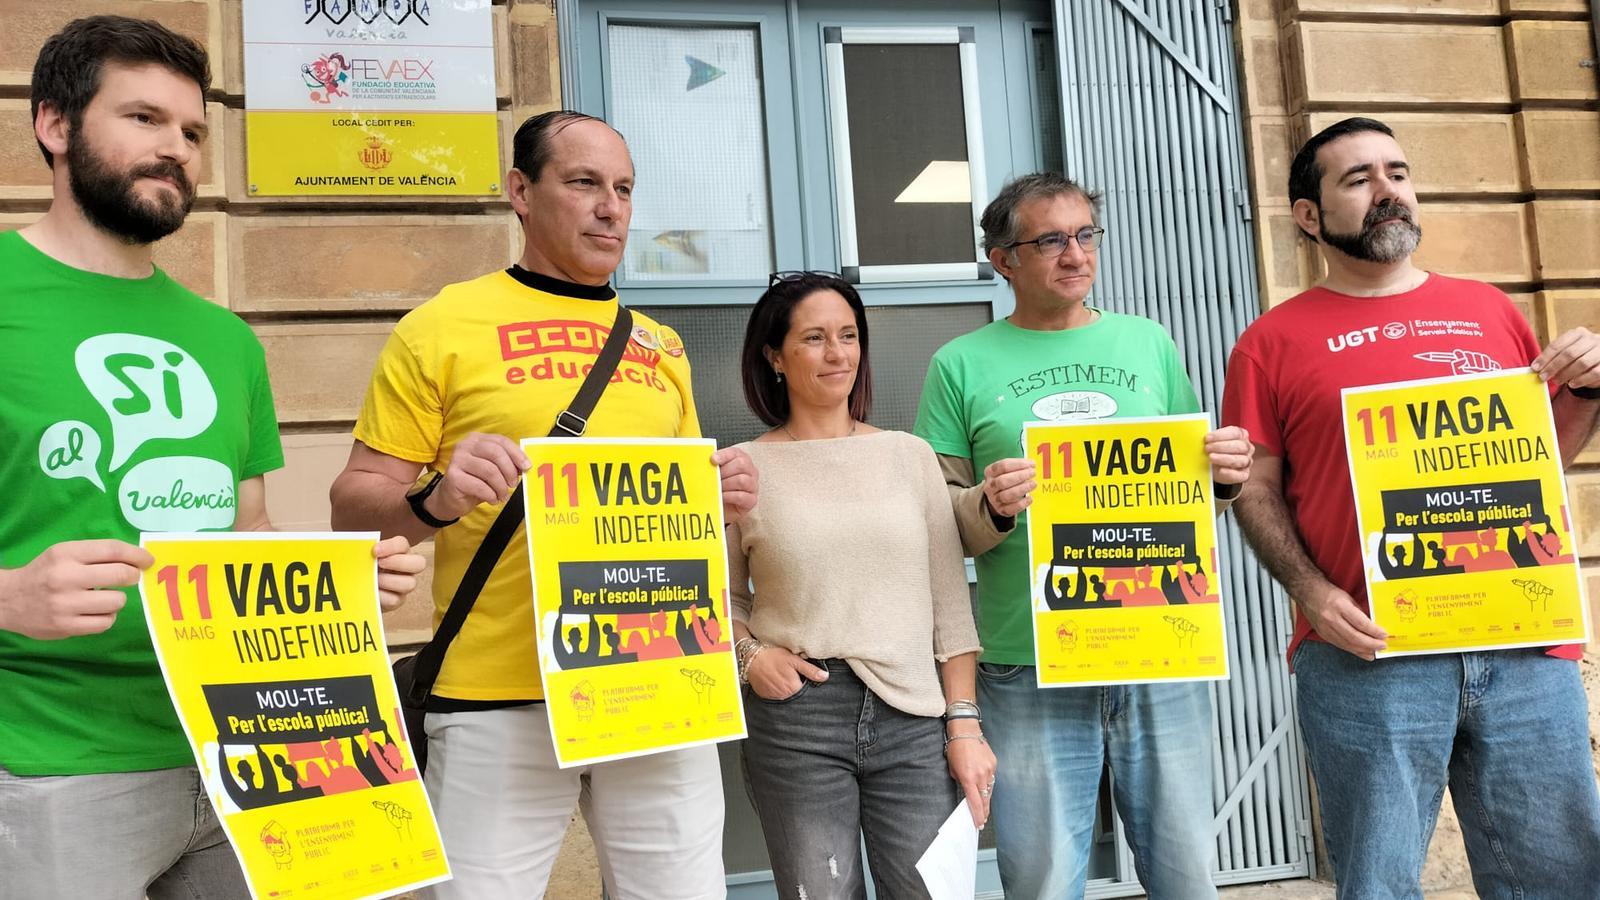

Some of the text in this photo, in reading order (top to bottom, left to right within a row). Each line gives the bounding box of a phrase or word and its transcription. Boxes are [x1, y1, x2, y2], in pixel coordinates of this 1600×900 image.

[351, 59, 435, 80] FEVAEX
[365, 119, 391, 127] CEDIT
[394, 119, 415, 127] PER:
[295, 176, 375, 185] AJUNTAMENT
[379, 176, 394, 185] DE
[1327, 319, 1480, 352] UGT Ensenyament
[1008, 364, 1139, 398] ESTIMEM
[1357, 393, 1514, 446] 11 VAGA
[46, 427, 83, 471] al
[1036, 437, 1177, 480] 11 VAGA
[1365, 435, 1550, 474] MAIG INDEFINIDA
[127, 479, 234, 511] valencià
[537, 462, 688, 508] 11 VAGA
[1042, 479, 1205, 510] MAIG INDEFINIDA
[1426, 489, 1497, 507] MOU-TE.
[545, 512, 717, 545] MAIG INDEFINIDA
[1395, 512, 1419, 526] Per
[1477, 503, 1532, 524] pública!
[1092, 528, 1156, 542] MOU-TE.
[1064, 546, 1084, 559] Per
[1137, 544, 1185, 561] pública!
[157, 561, 341, 621] 11 VAGA
[604, 567, 670, 584] MOU-TE.
[573, 589, 596, 605] Per
[651, 585, 699, 605] pública!
[174, 620, 378, 664] MAIG INDEFINIDA
[256, 687, 333, 709] MOU-TE.
[227, 715, 255, 735] Per
[316, 706, 370, 732] pública!
